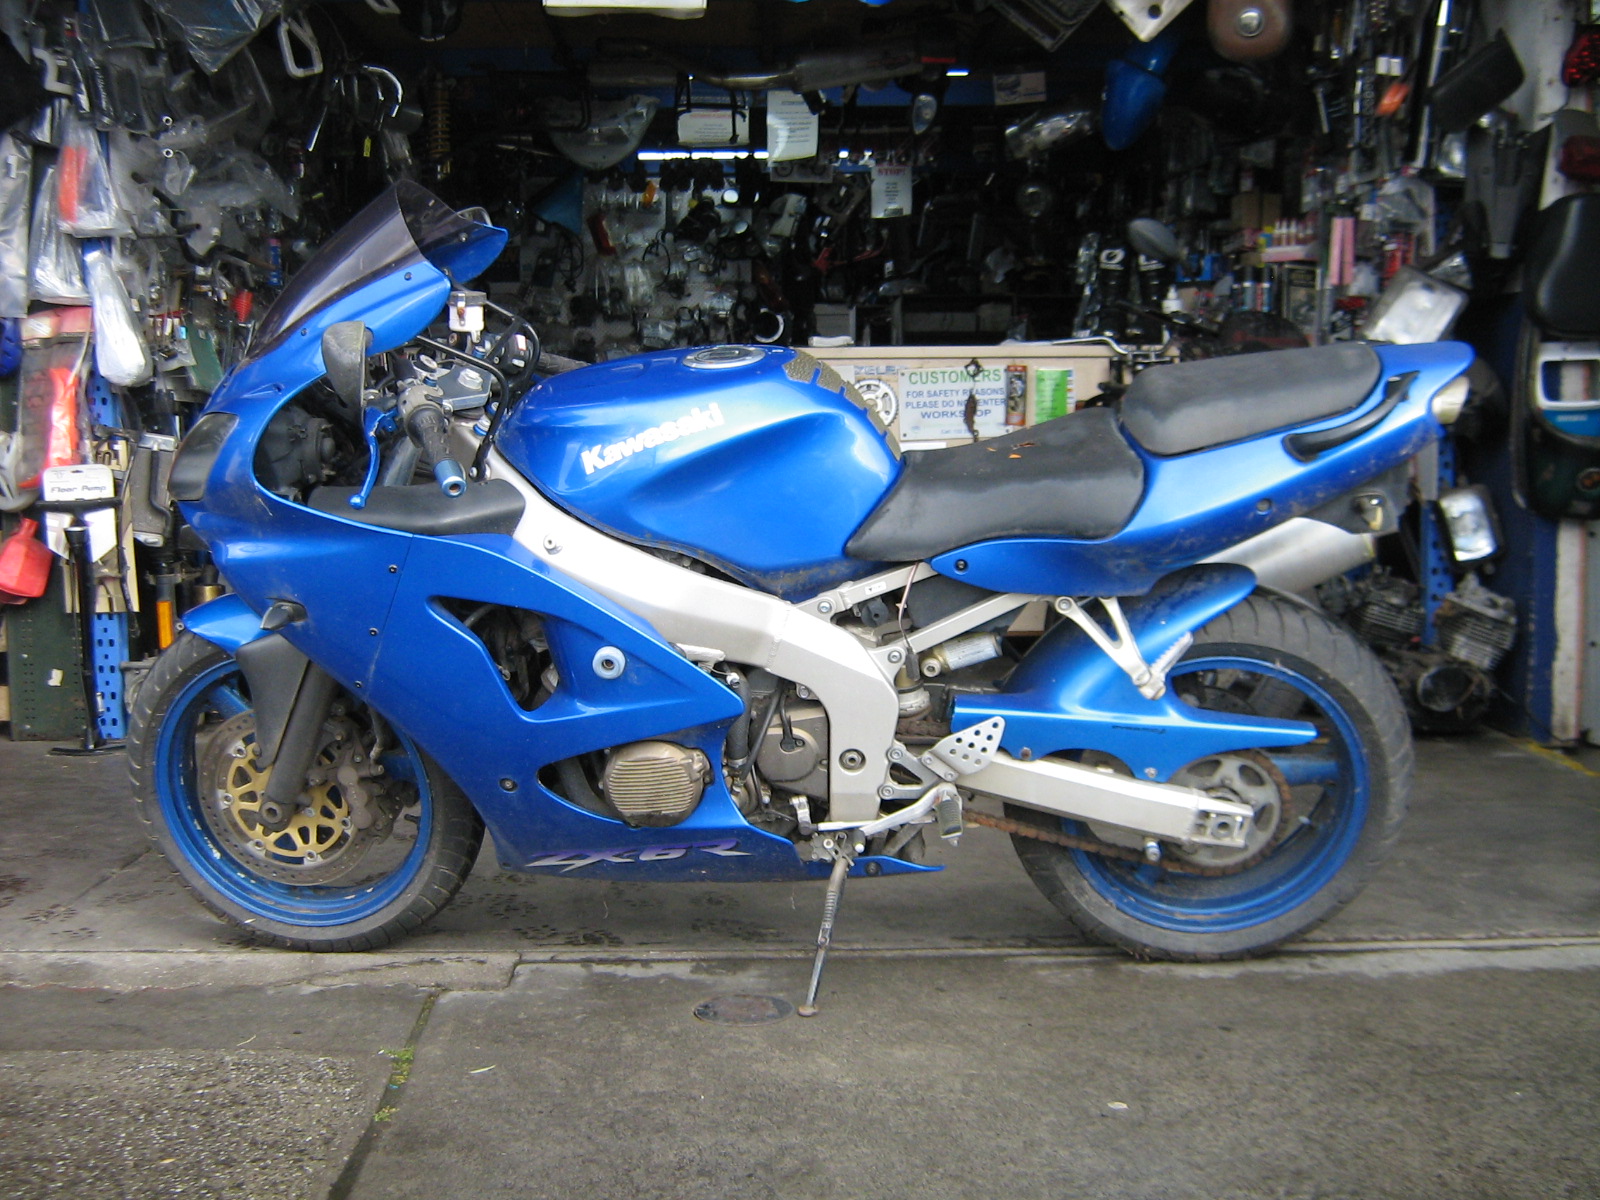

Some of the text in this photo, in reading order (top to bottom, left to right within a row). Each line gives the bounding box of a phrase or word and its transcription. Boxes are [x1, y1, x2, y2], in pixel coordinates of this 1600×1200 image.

[927, 389, 960, 397] SAFETY
[905, 401, 939, 409] PLEASE
[942, 400, 954, 408] DO
[921, 409, 992, 419] WORKSOP
[581, 402, 725, 475] Kawasaki
[81, 485, 106, 493] Pump
